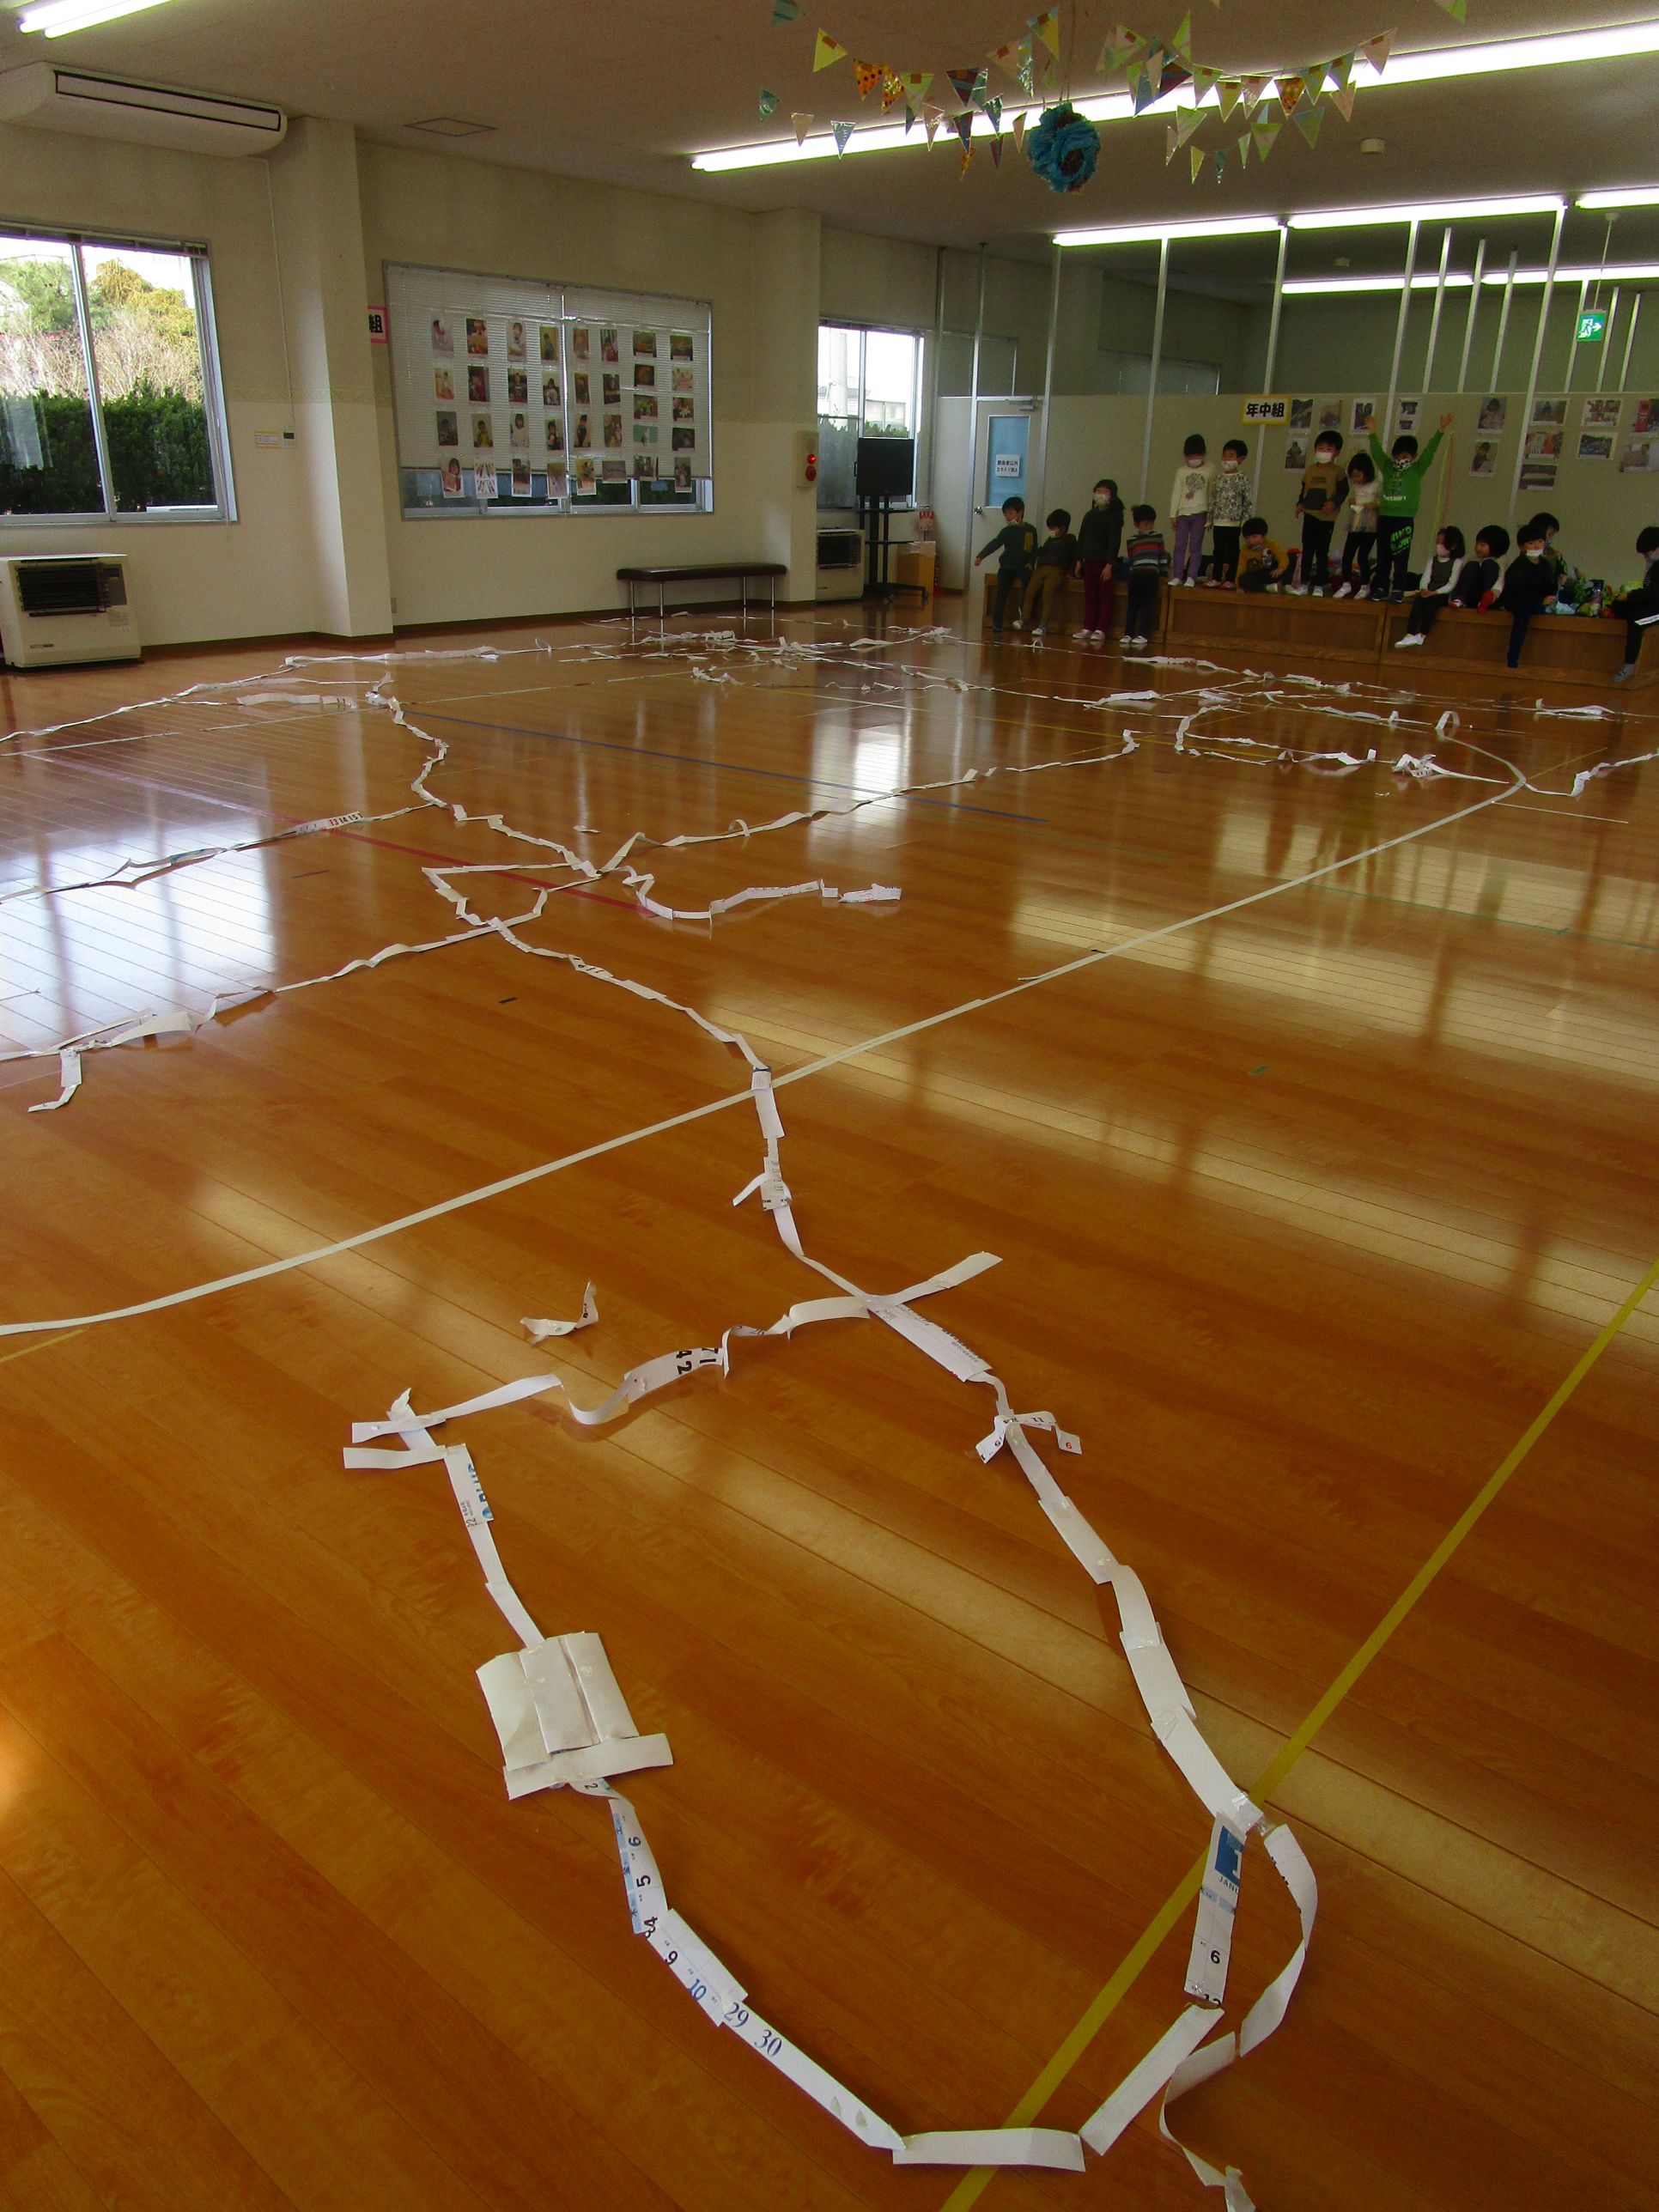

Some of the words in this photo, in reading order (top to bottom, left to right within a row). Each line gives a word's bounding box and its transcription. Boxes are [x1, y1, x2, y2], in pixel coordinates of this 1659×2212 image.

[1245, 402, 1285, 417] 年中組
[329, 818, 339, 827] 13
[628, 1836, 641, 1847] 6
[636, 1875, 651, 1887] 5
[1210, 1949, 1221, 1964] 6
[665, 1950, 678, 1966] 9
[688, 1978, 707, 2001] 10
[724, 2002, 750, 2027] 29
[753, 2029, 782, 2057] 30
